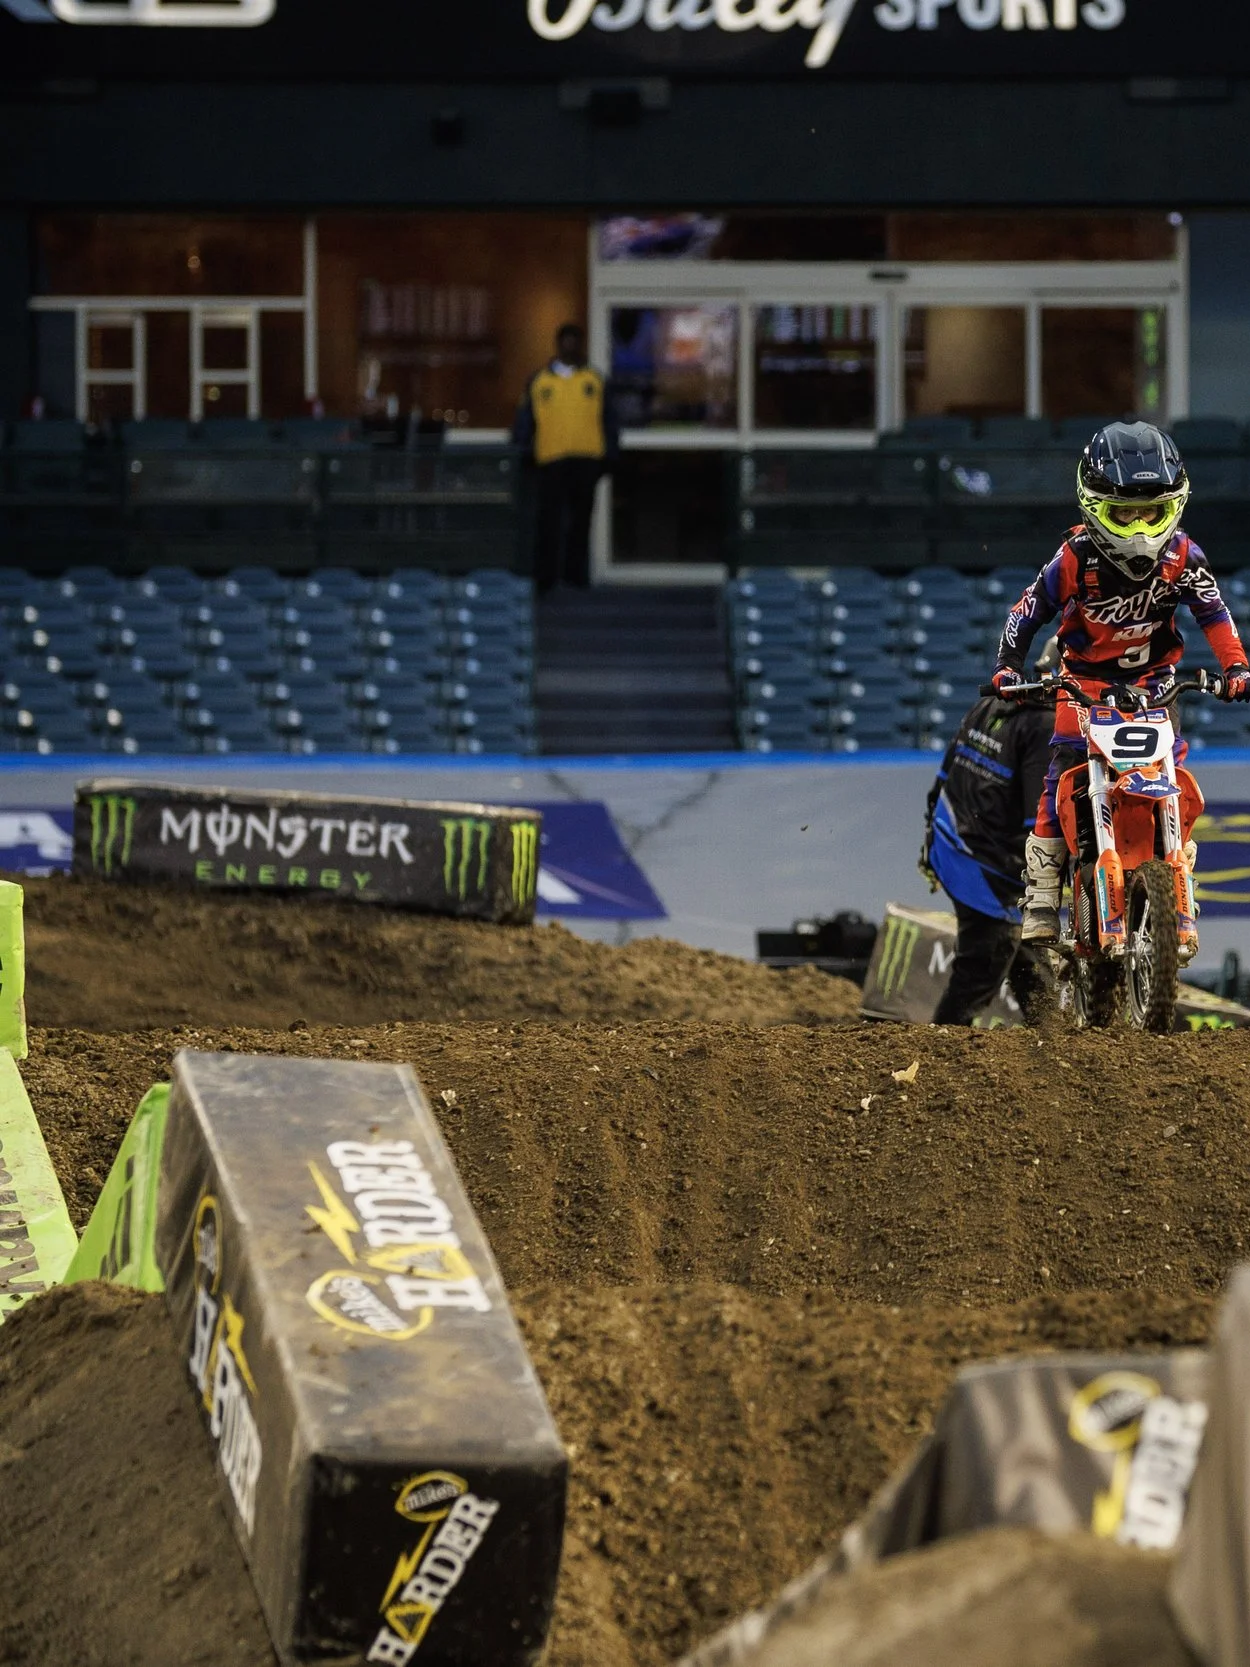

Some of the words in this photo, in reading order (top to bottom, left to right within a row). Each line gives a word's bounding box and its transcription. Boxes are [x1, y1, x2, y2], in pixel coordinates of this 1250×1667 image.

[1111, 726, 1159, 759] 9
[1141, 784, 1169, 792] KTM
[160, 803, 414, 864] MONSTER
[194, 859, 374, 891] ENERGY
[1107, 873, 1120, 913] DUNLOP
[326, 1140, 493, 1313] HARDER
[366, 1493, 501, 1667] HARDER
